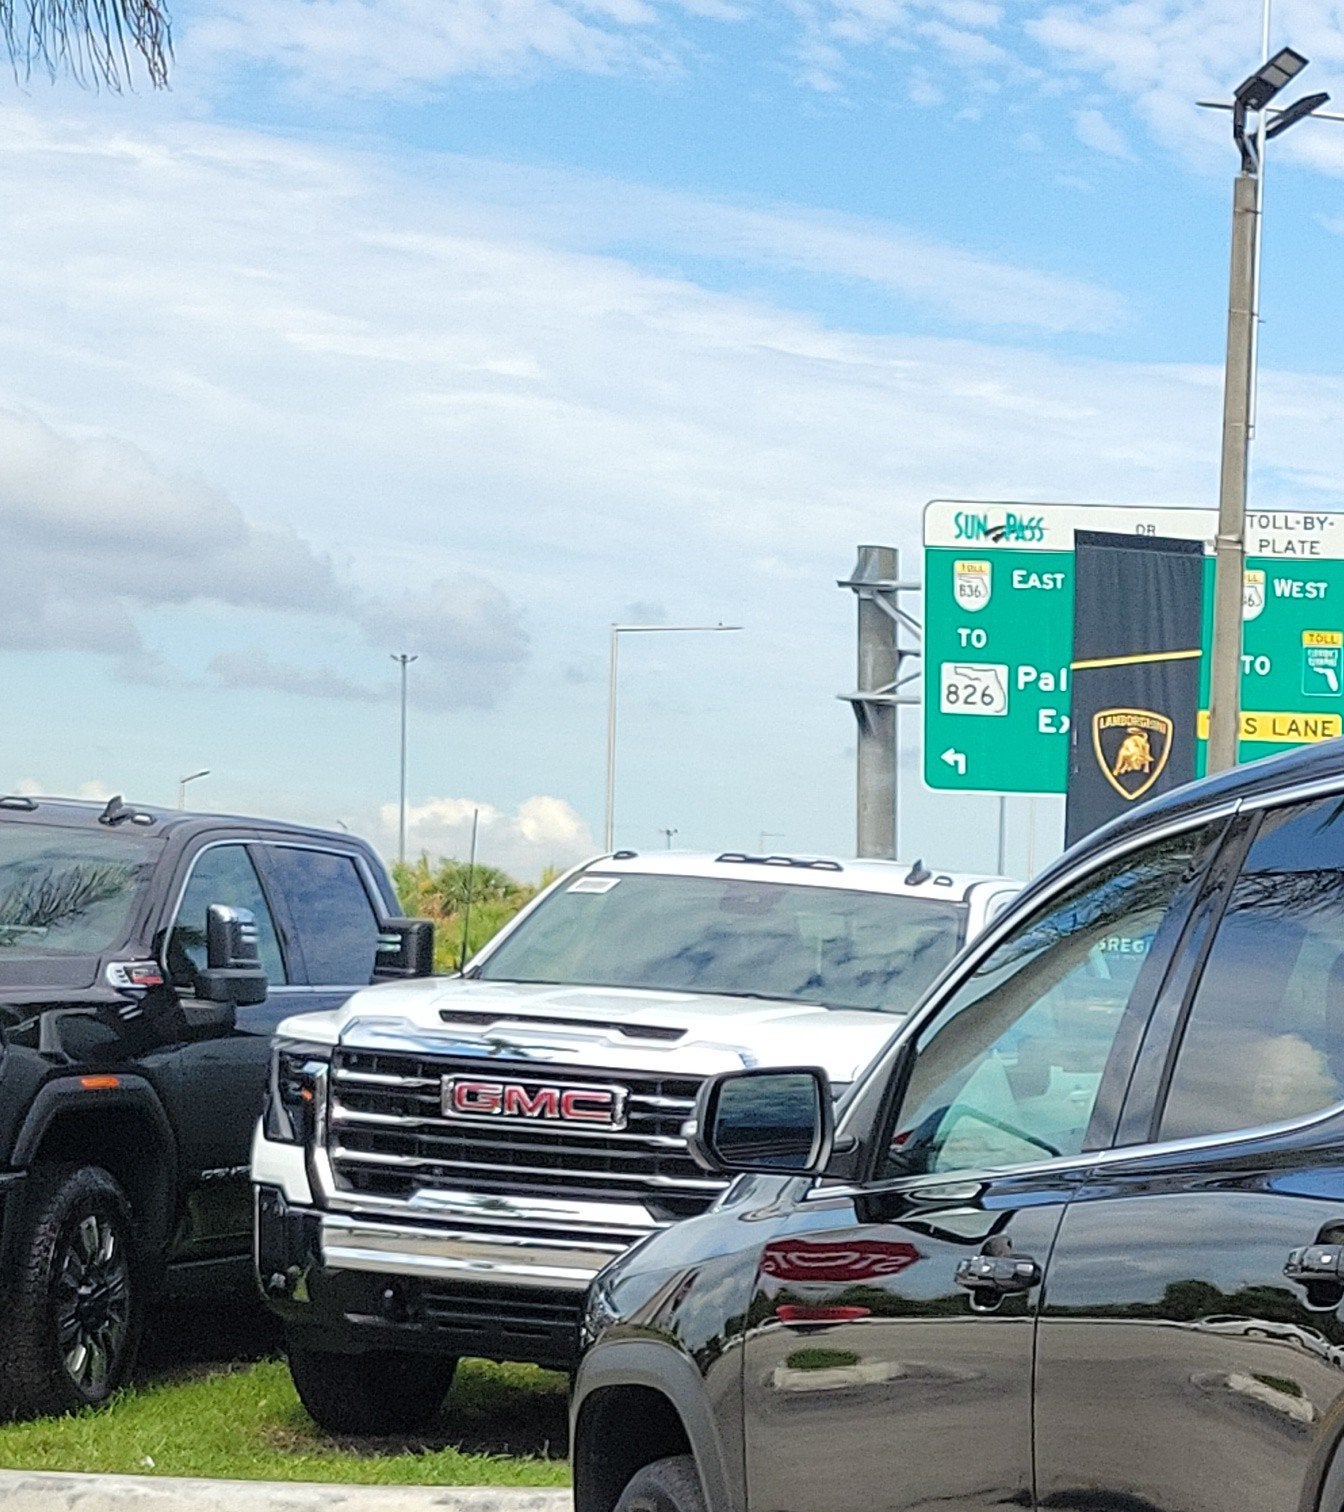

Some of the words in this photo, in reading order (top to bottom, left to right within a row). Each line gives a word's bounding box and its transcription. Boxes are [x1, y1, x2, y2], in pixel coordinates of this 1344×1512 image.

[1259, 540, 1320, 555] PLATE
[1012, 569, 1066, 590] EAST
[1273, 579, 1328, 599] WEST
[957, 628, 987, 648] TO
[1309, 633, 1338, 645] TOLL
[1241, 655, 1271, 676] TO
[946, 684, 994, 706] 826
[1272, 719, 1334, 738] LANE
[454, 1082, 613, 1122] GMC
